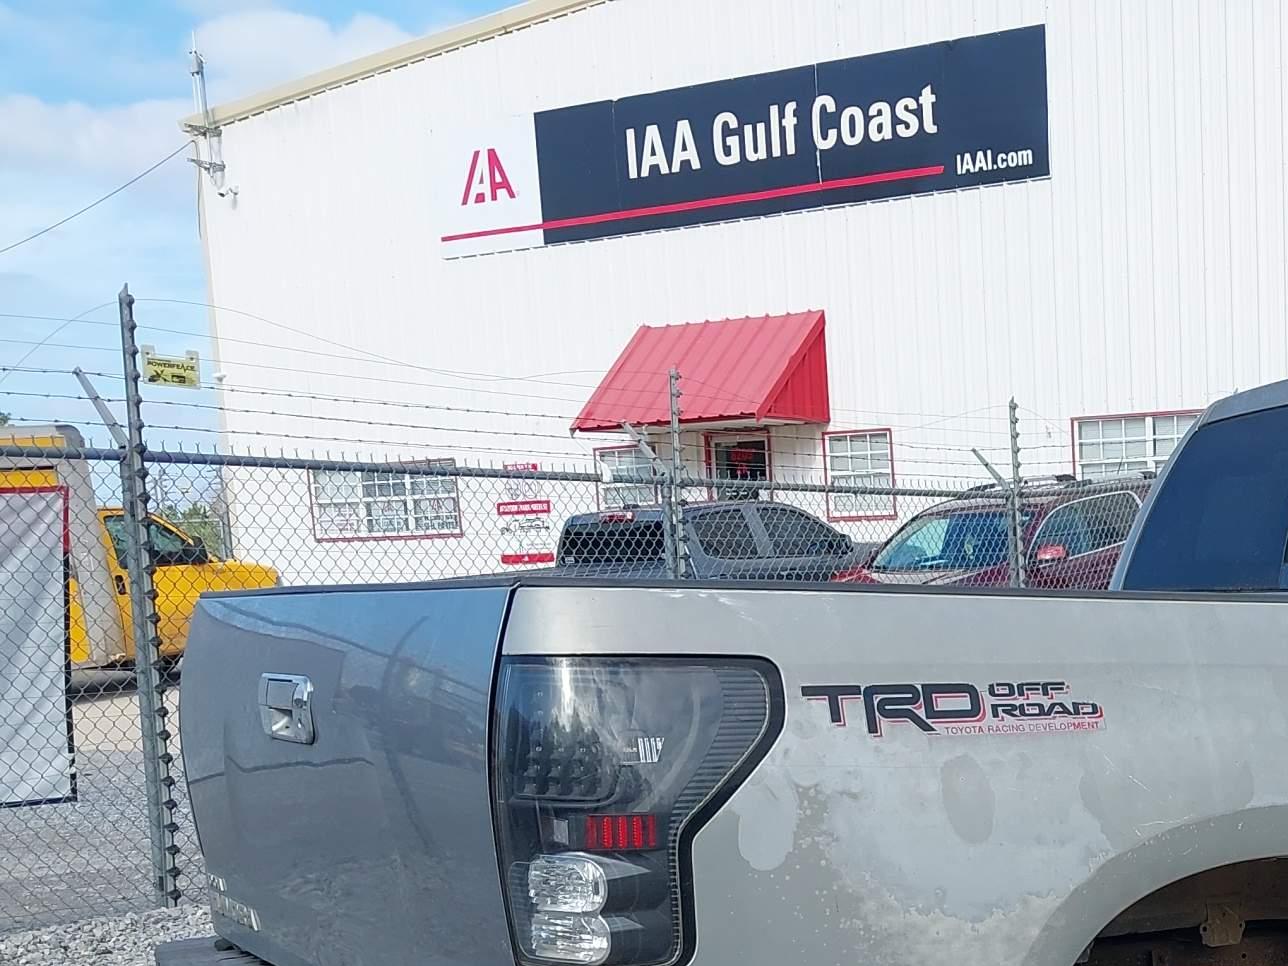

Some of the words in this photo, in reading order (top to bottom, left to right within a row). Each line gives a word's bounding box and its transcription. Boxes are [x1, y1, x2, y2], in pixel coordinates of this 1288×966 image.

[625, 119, 701, 179] IAA
[712, 101, 797, 166] Gulf
[811, 84, 938, 151] Coast
[956, 149, 1033, 175] IAAI.com
[987, 681, 1069, 700] OFF
[801, 682, 986, 738] TRD
[990, 700, 1104, 719] ROAD
[945, 726, 984, 735] TOYOTA
[987, 723, 1026, 733] RACING
[1029, 720, 1100, 732] DEVELOPMENT
